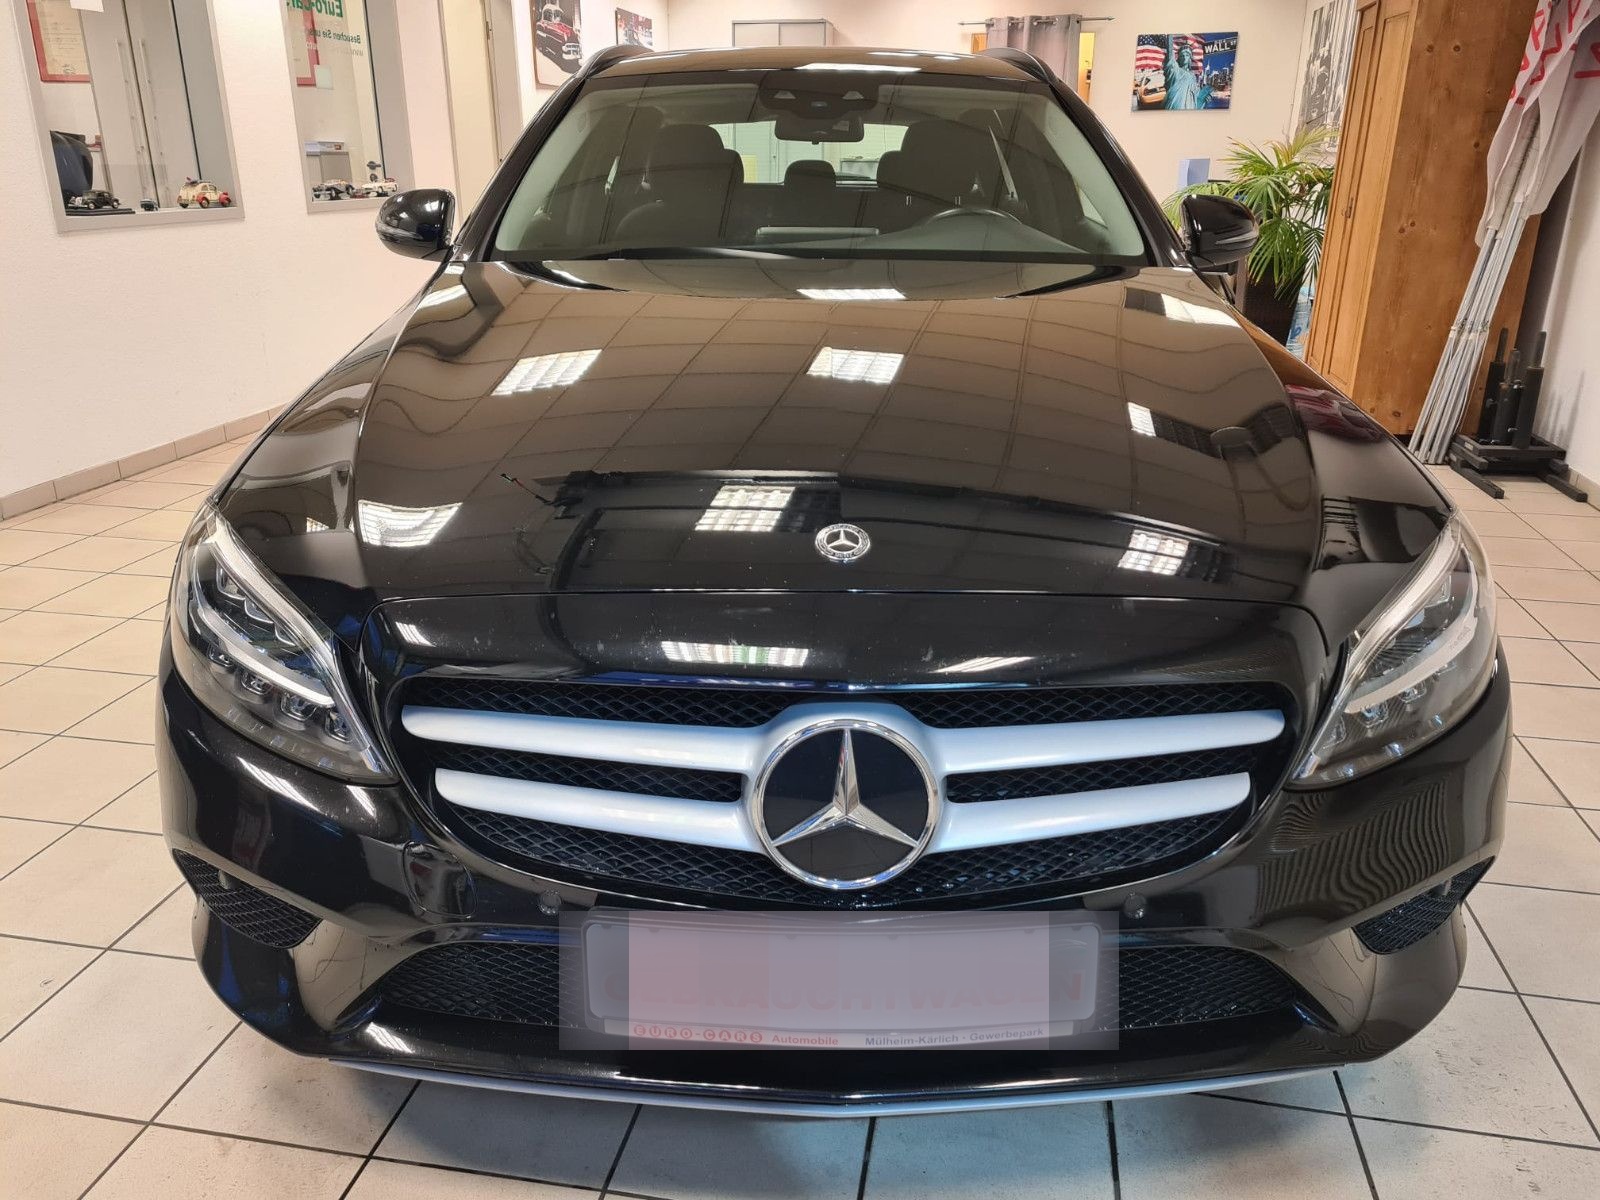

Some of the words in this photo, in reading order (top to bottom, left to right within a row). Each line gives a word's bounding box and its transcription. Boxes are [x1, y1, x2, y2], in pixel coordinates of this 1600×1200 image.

[1205, 42, 1230, 53] WALL
[634, 1024, 763, 1043] EURO-CARS
[772, 1034, 839, 1046] Automobile
[865, 1035, 959, 1046] Mülheim-Kärlich
[970, 1027, 1044, 1041] Gewerbepark
